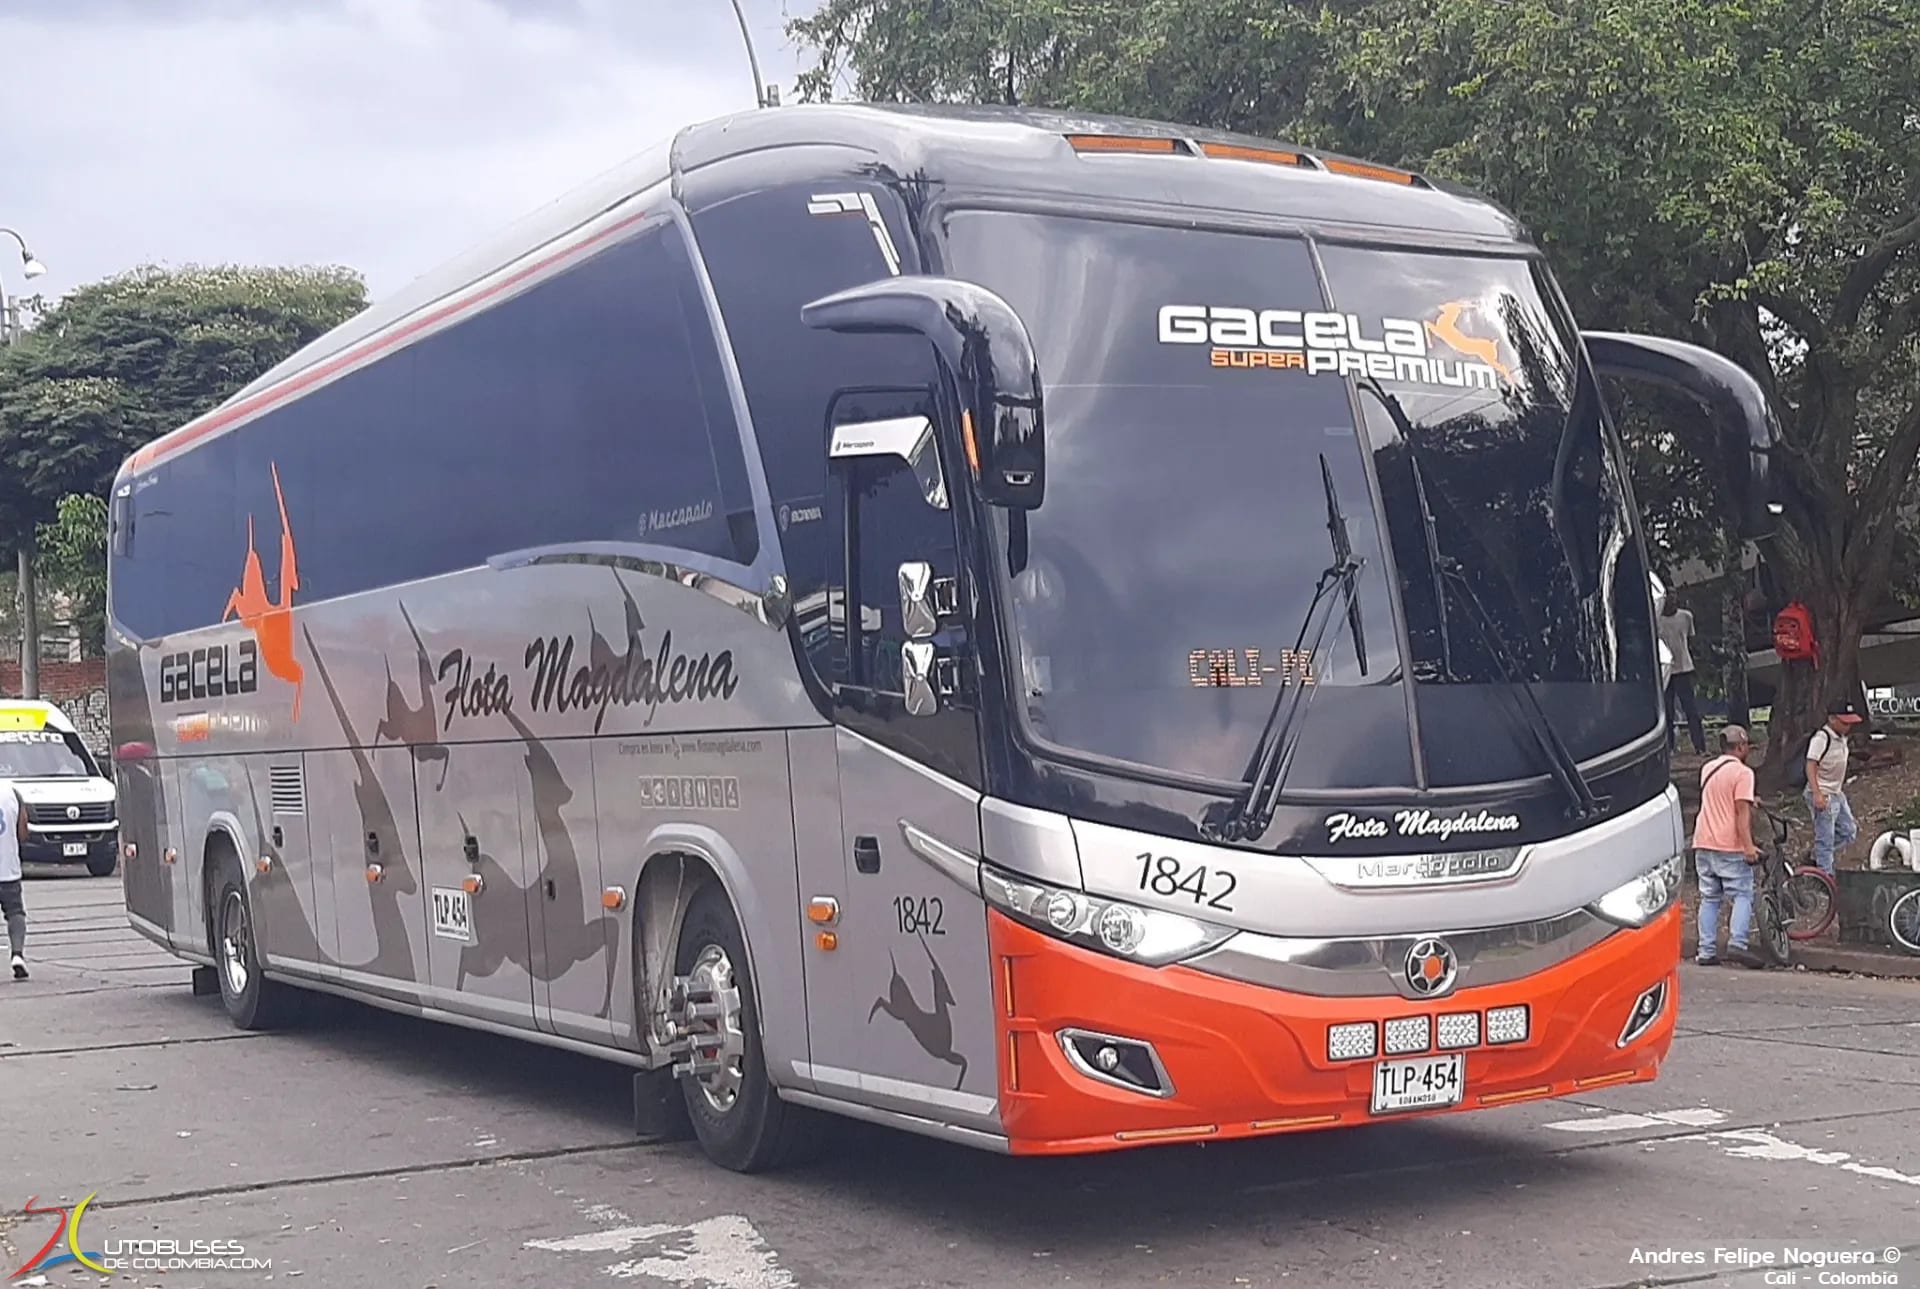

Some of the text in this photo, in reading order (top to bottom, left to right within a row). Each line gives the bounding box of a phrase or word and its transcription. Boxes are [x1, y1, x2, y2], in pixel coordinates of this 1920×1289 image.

[1306, 351, 1498, 390] PREMIUM
[438, 630, 739, 736] Flota Magdalena
[1324, 809, 1520, 844] Flota Magdalena
[1136, 852, 1237, 912] 1842
[893, 896, 946, 936] 1842
